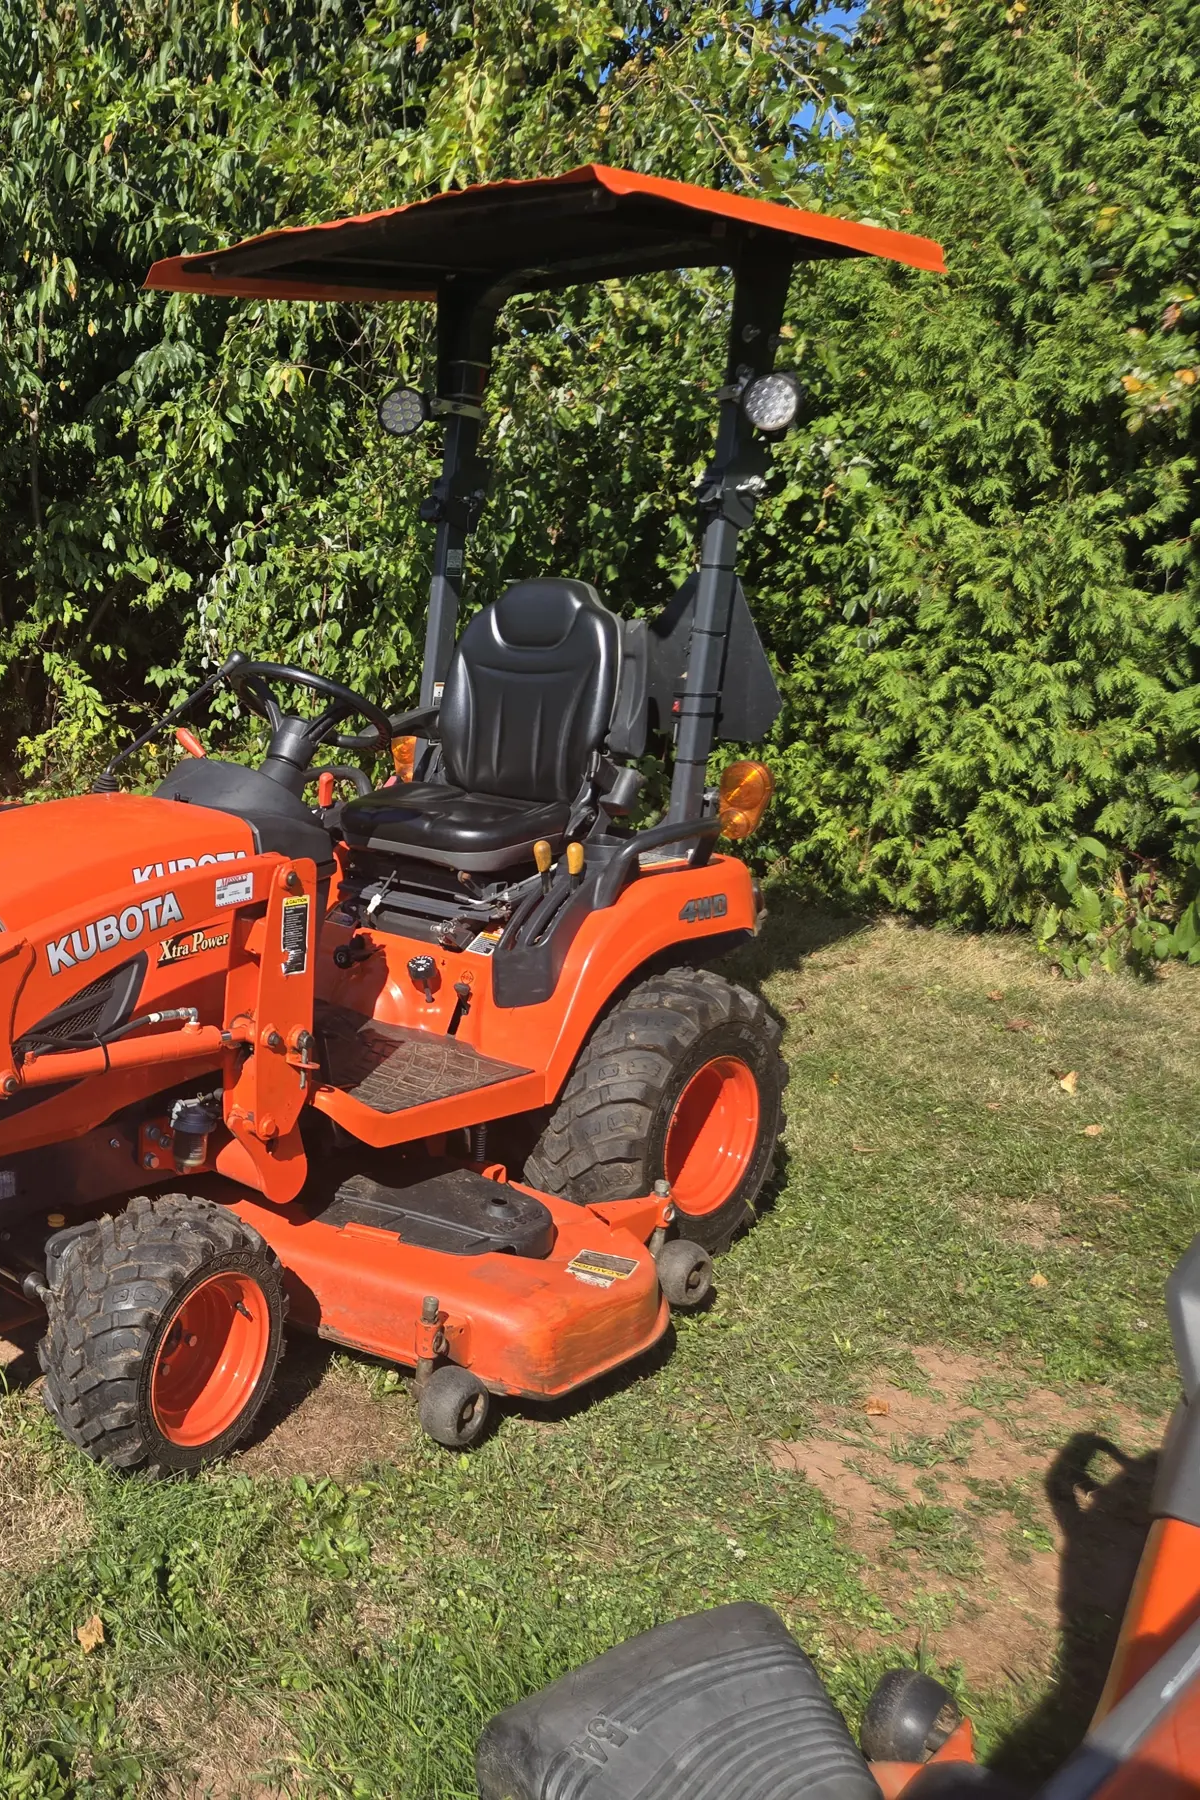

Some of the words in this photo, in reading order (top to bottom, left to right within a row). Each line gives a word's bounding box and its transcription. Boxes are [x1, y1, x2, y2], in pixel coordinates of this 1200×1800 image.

[679, 894, 728, 923] 4WD
[45, 891, 184, 976] KUBOTA
[158, 938, 189, 961] Xtra
[191, 931, 229, 953] Power
[570, 1715, 630, 1765] 54
